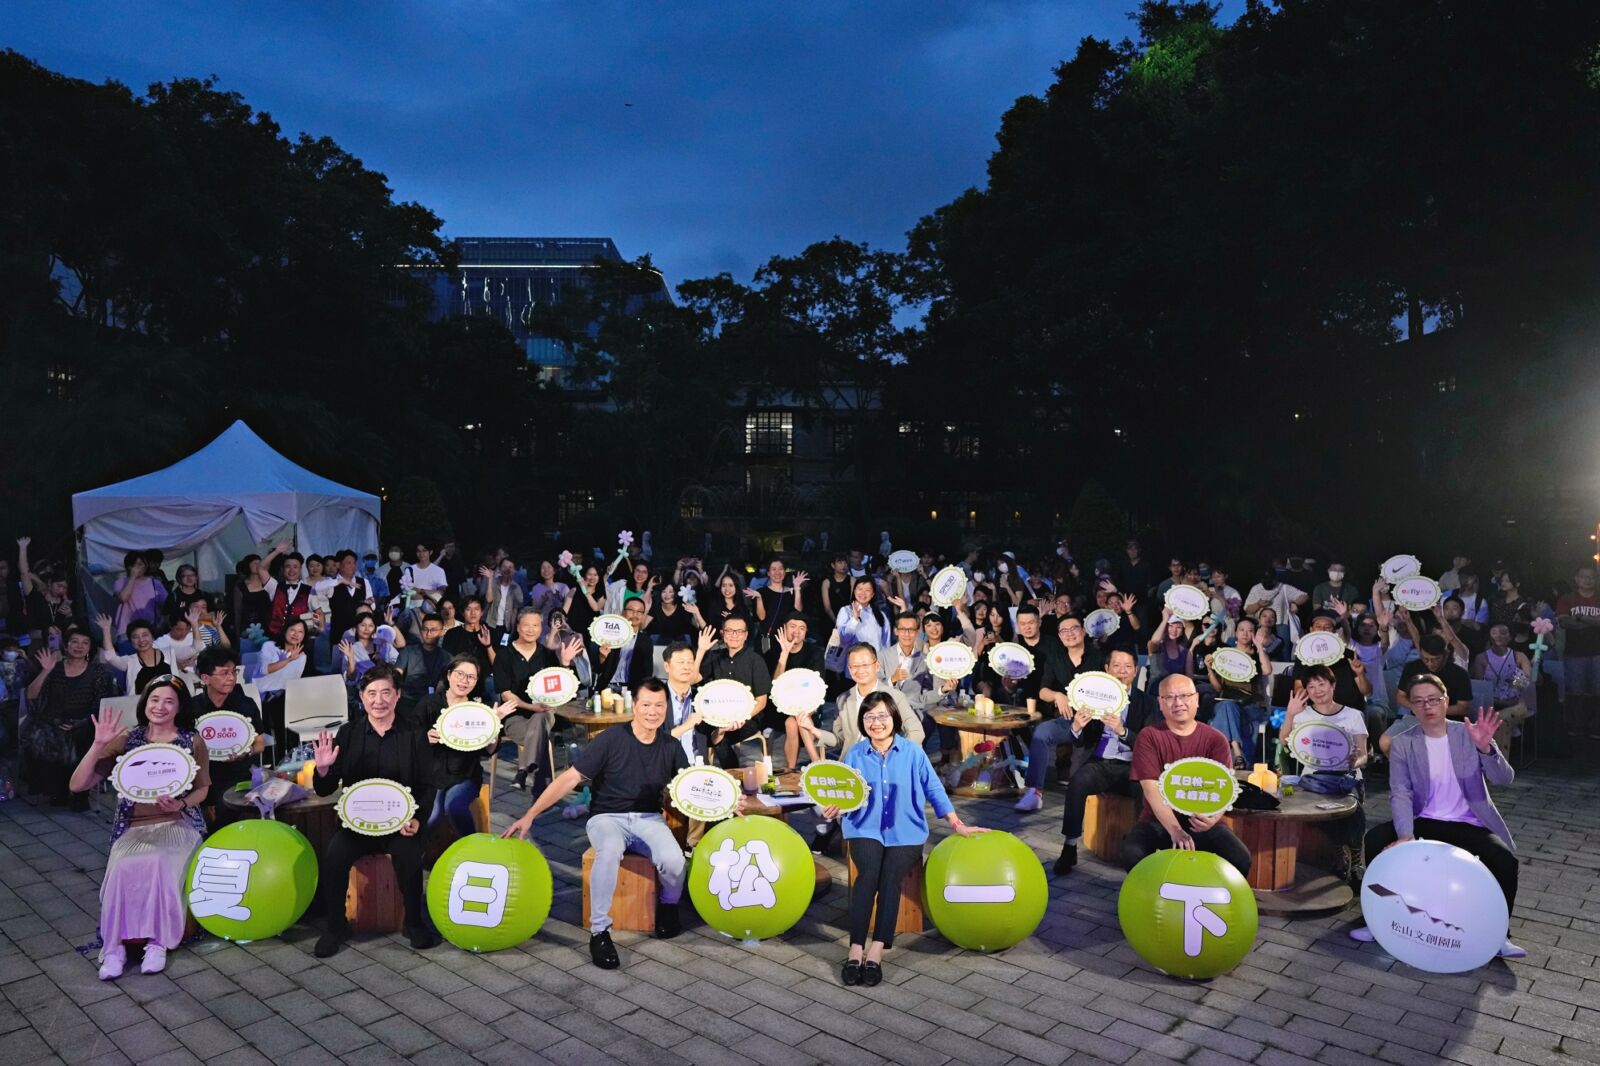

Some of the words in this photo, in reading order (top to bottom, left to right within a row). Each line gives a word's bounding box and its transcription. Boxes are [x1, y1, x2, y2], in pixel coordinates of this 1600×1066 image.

[604, 621, 621, 631] TdA
[1170, 774, 1227, 789] 夏日松一下
[188, 846, 258, 921] 夏
[448, 861, 510, 929] 日
[708, 838, 780, 911] 松
[1159, 882, 1232, 958] 下
[1391, 920, 1462, 949] 松山文創園區
